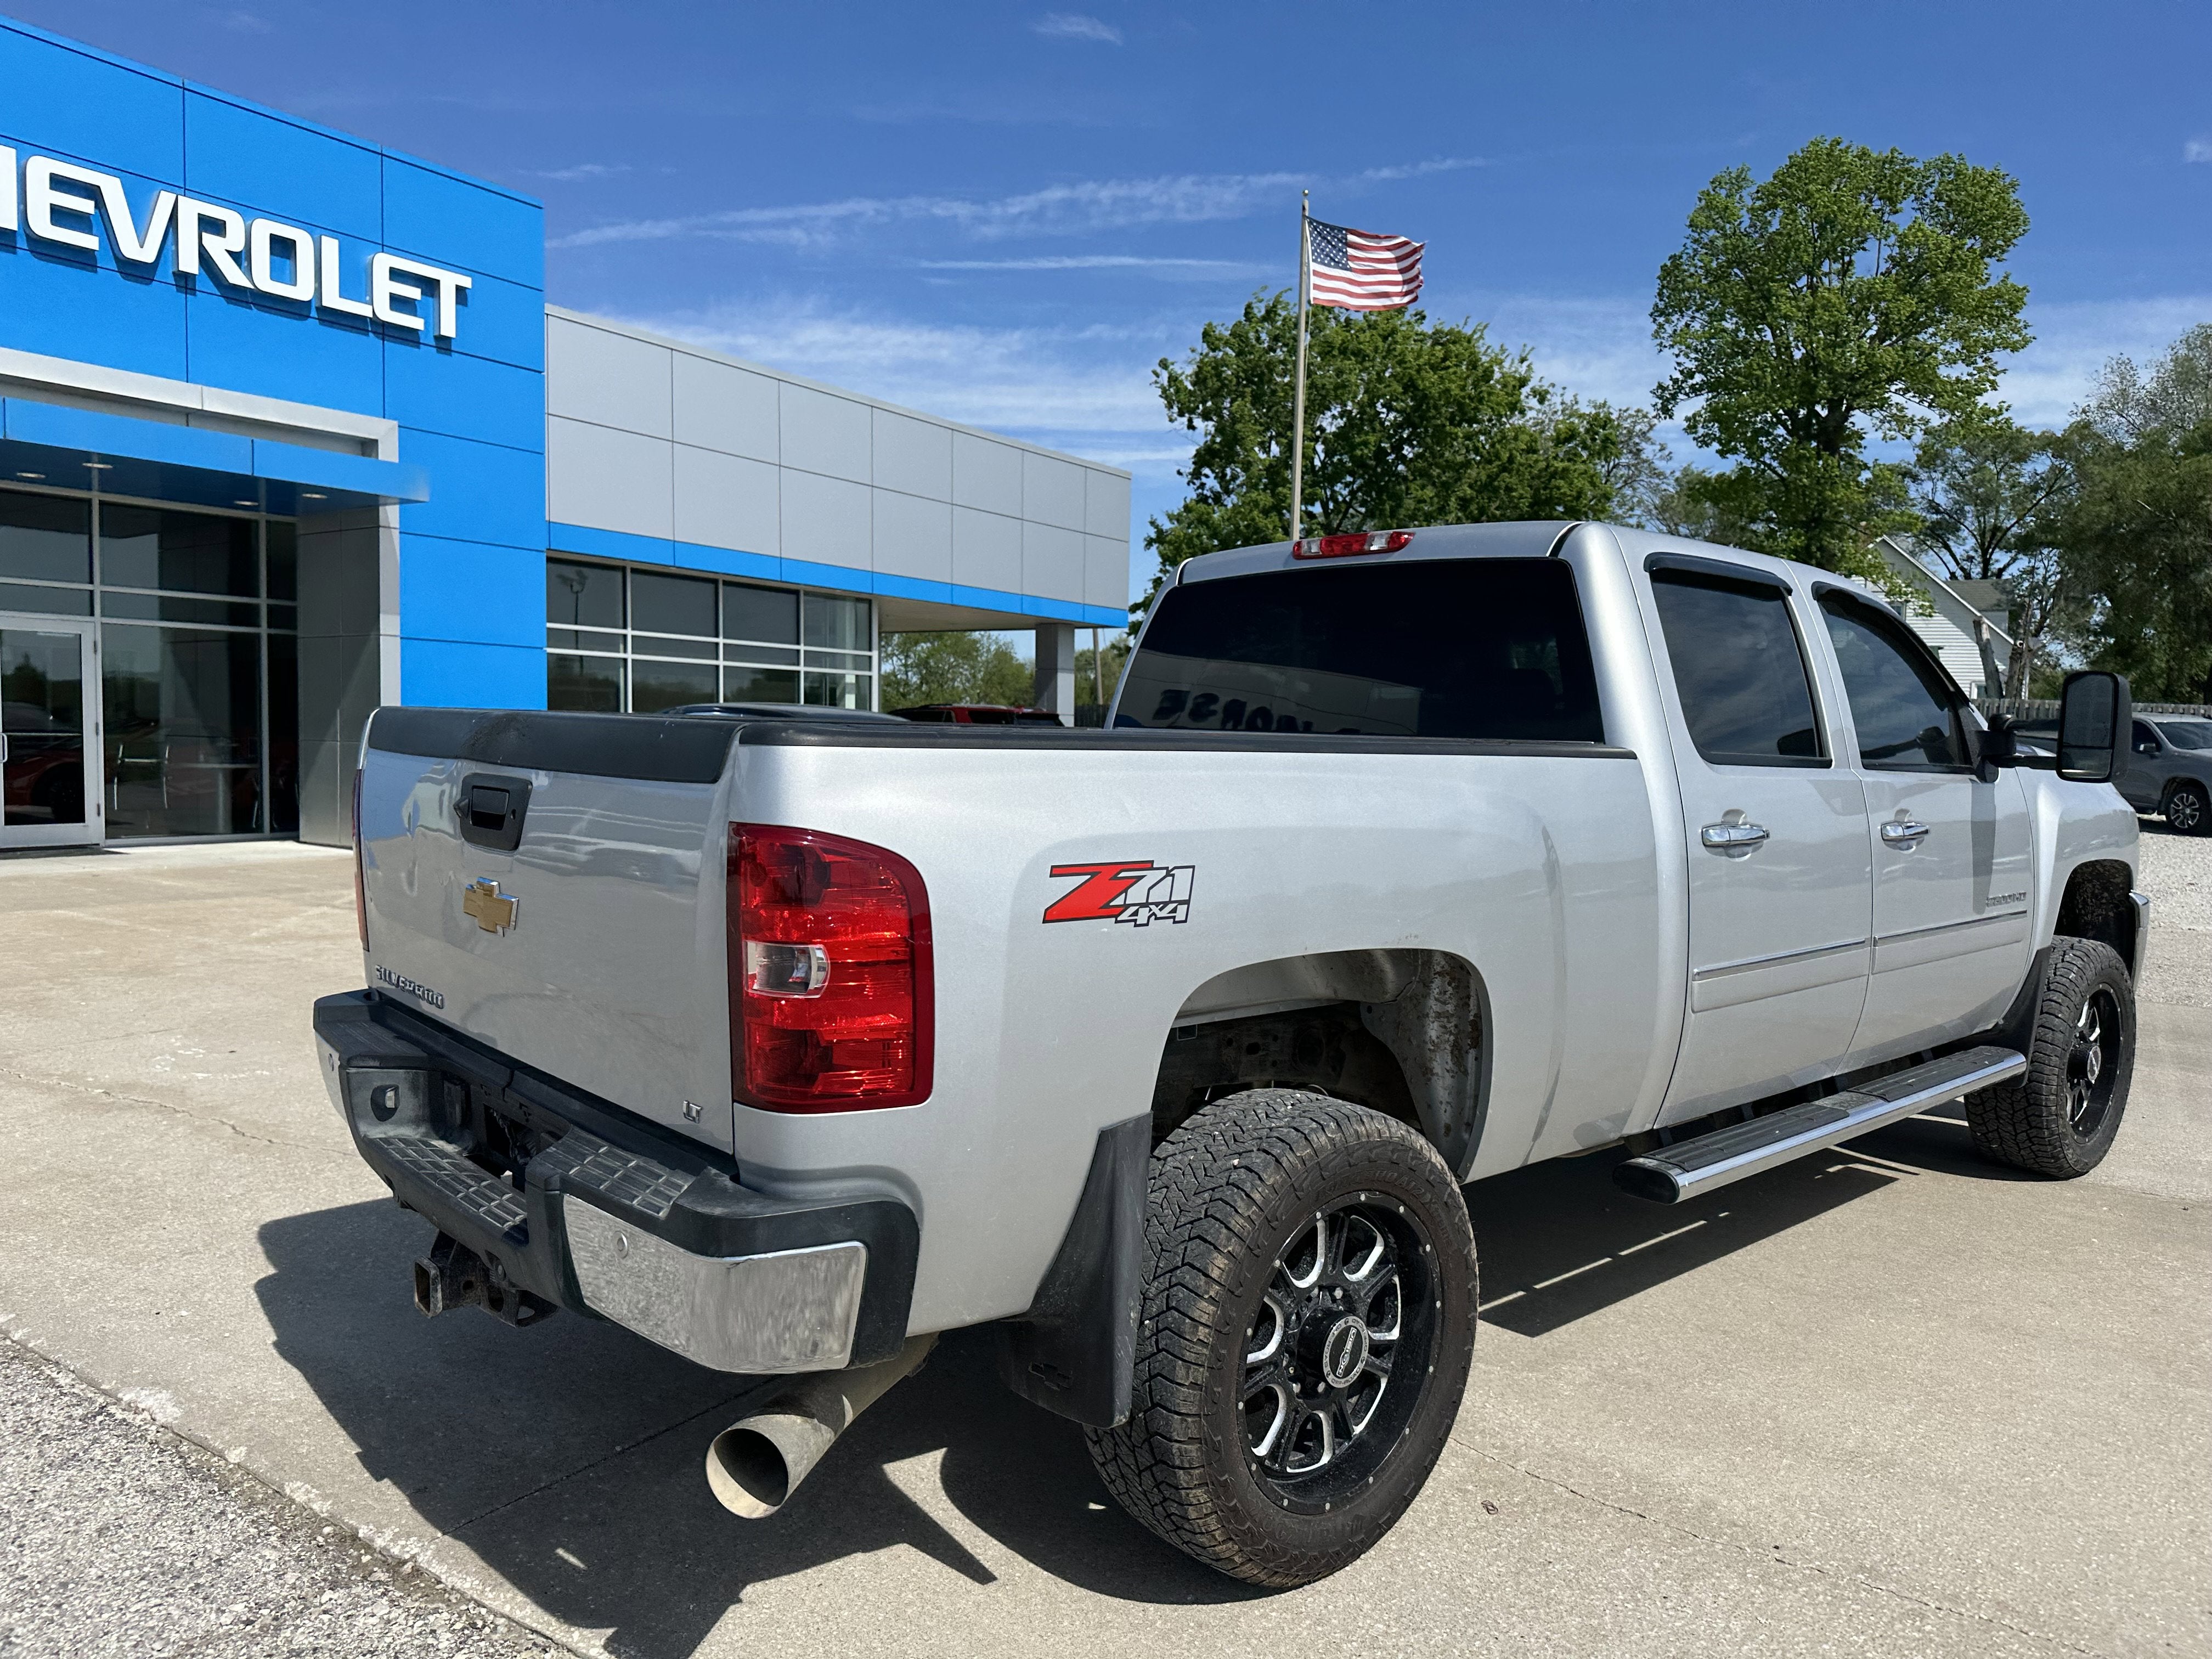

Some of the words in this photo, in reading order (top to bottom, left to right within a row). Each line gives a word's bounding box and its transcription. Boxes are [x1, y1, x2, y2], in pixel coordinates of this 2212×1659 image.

[0, 144, 472, 338] EVROLET
[1042, 860, 1195, 924] Z71
[375, 964, 443, 1009] SILVERADO
[682, 1100, 703, 1124] LT
